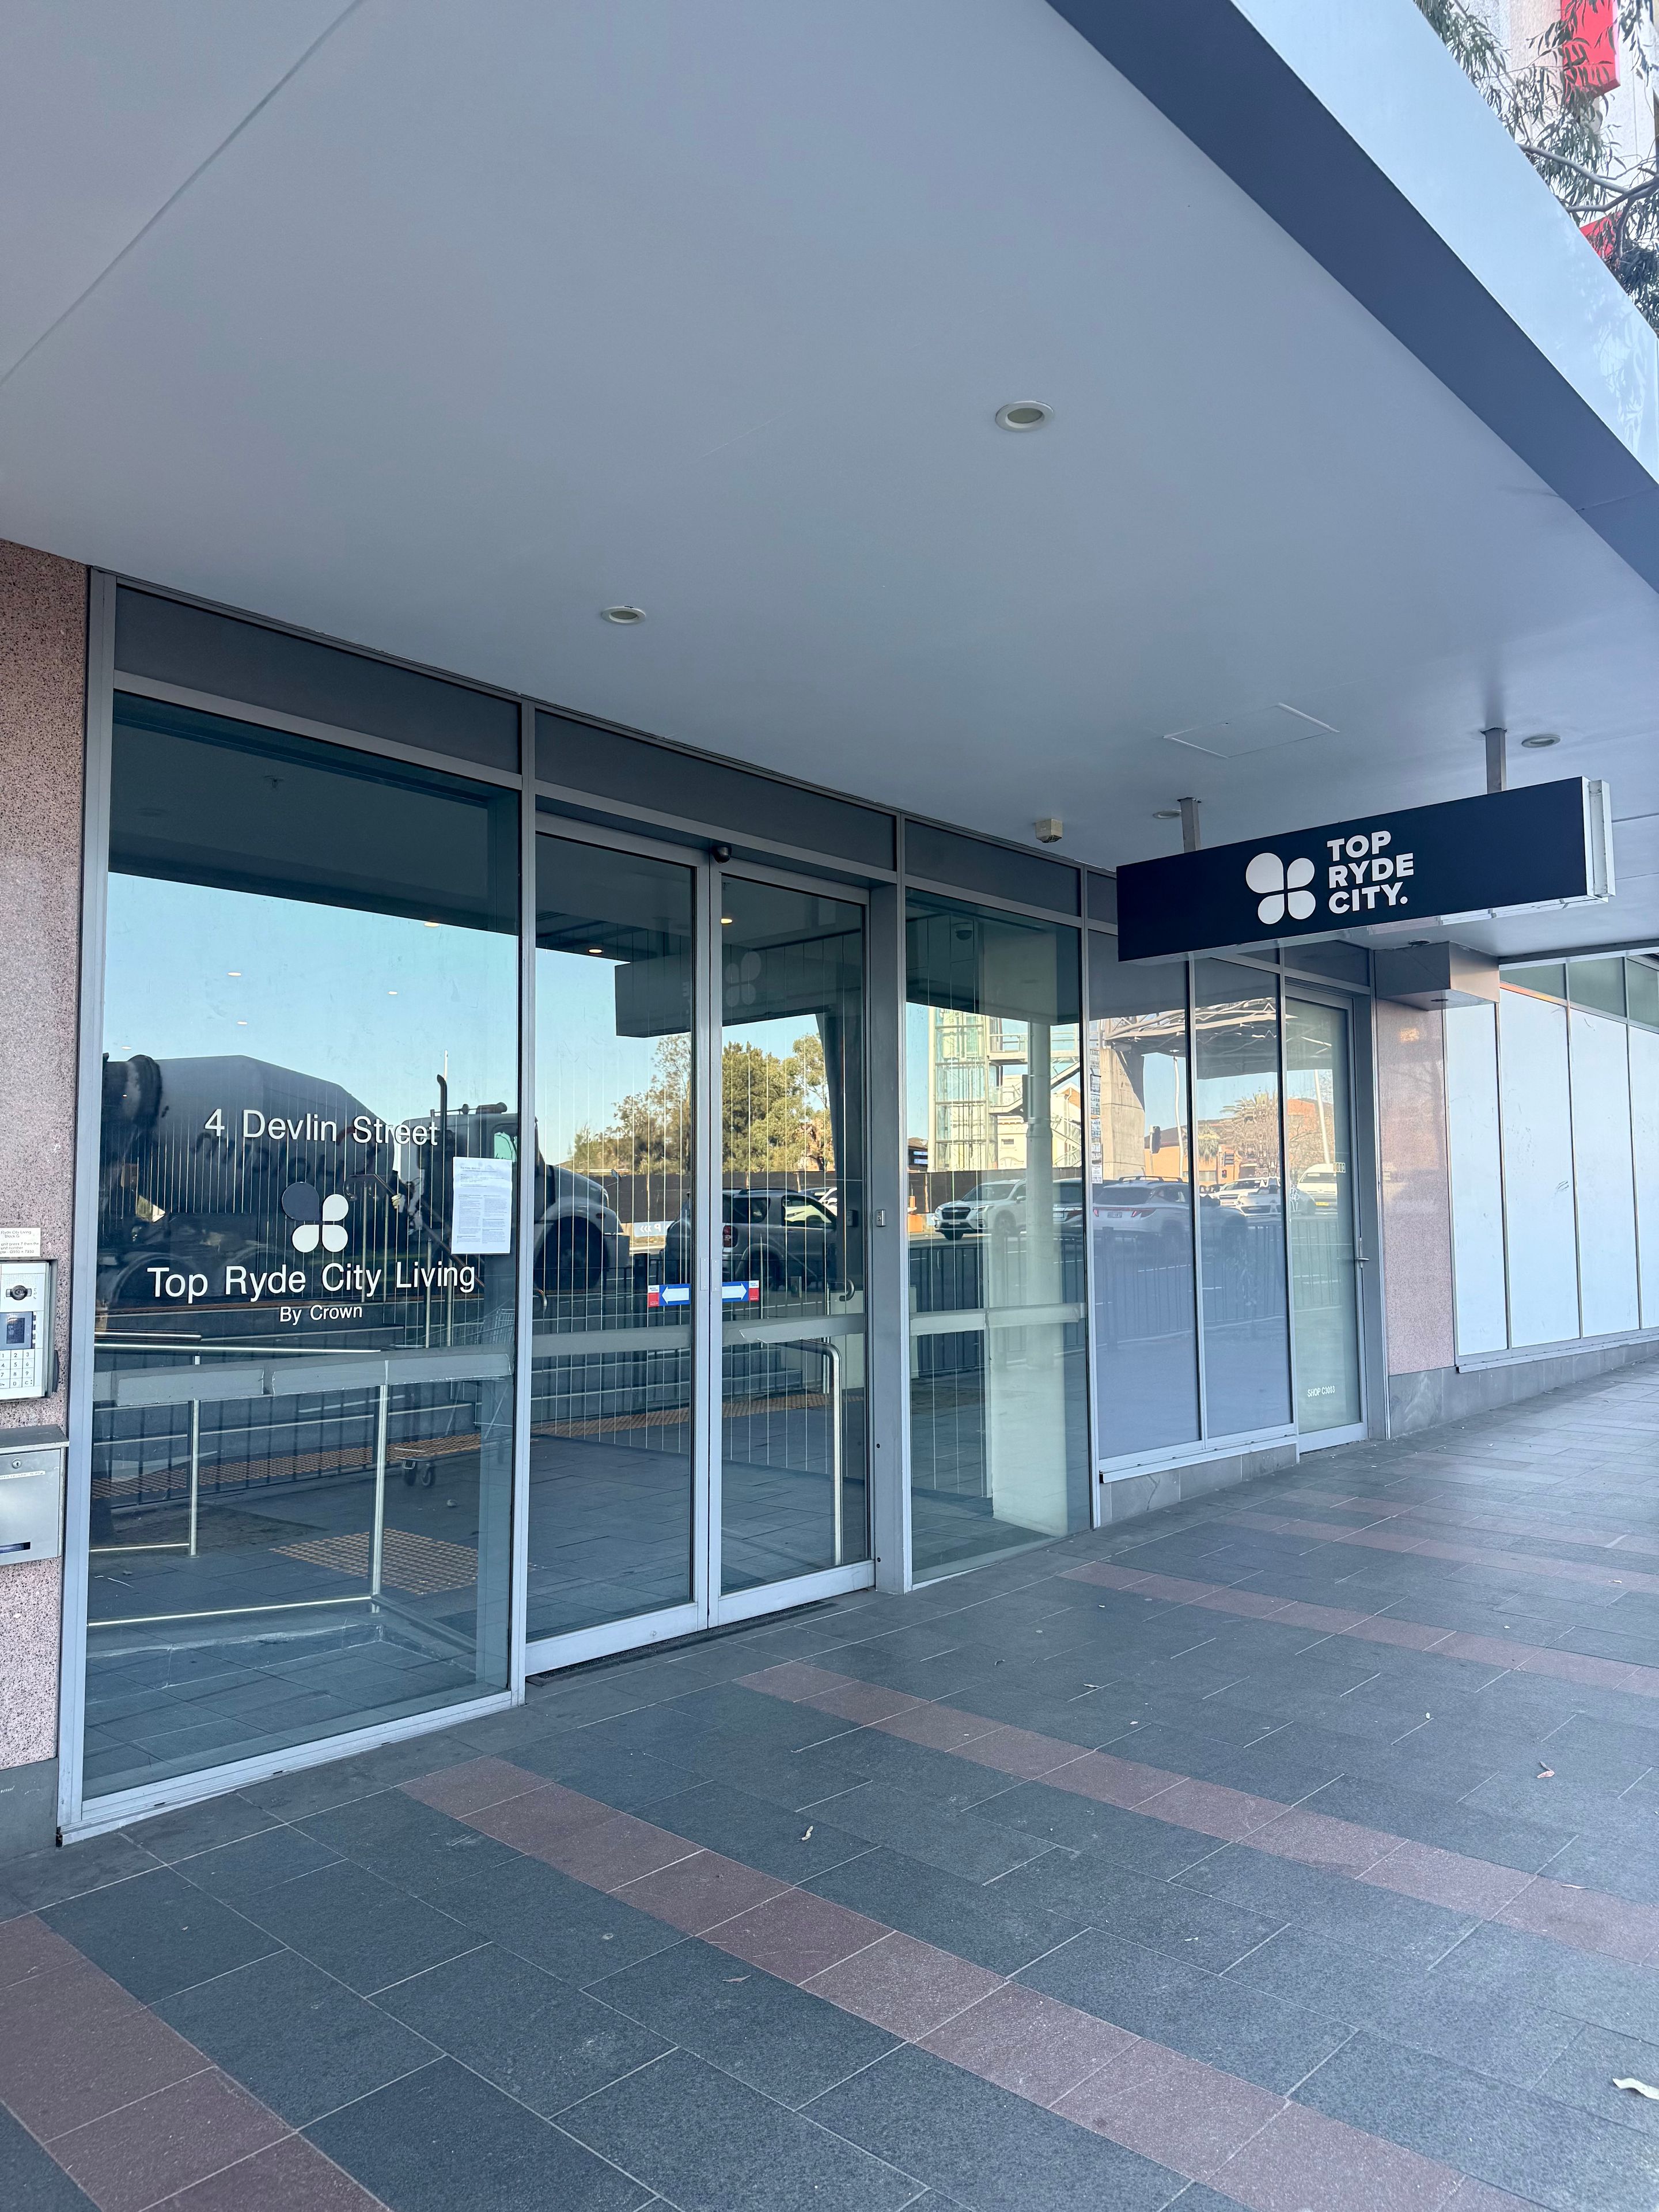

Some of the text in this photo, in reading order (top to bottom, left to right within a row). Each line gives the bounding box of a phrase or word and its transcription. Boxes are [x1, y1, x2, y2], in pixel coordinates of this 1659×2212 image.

[1327, 830, 1392, 862] TOP
[1329, 853, 1414, 889] RYDE
[1328, 881, 1408, 914] CITY.
[204, 1108, 439, 1146] 4 Devlin Street
[147, 1261, 475, 1304] Top Ryde City Living
[280, 1304, 363, 1325] By Crown
[1308, 1388, 1321, 1397] SHOP
